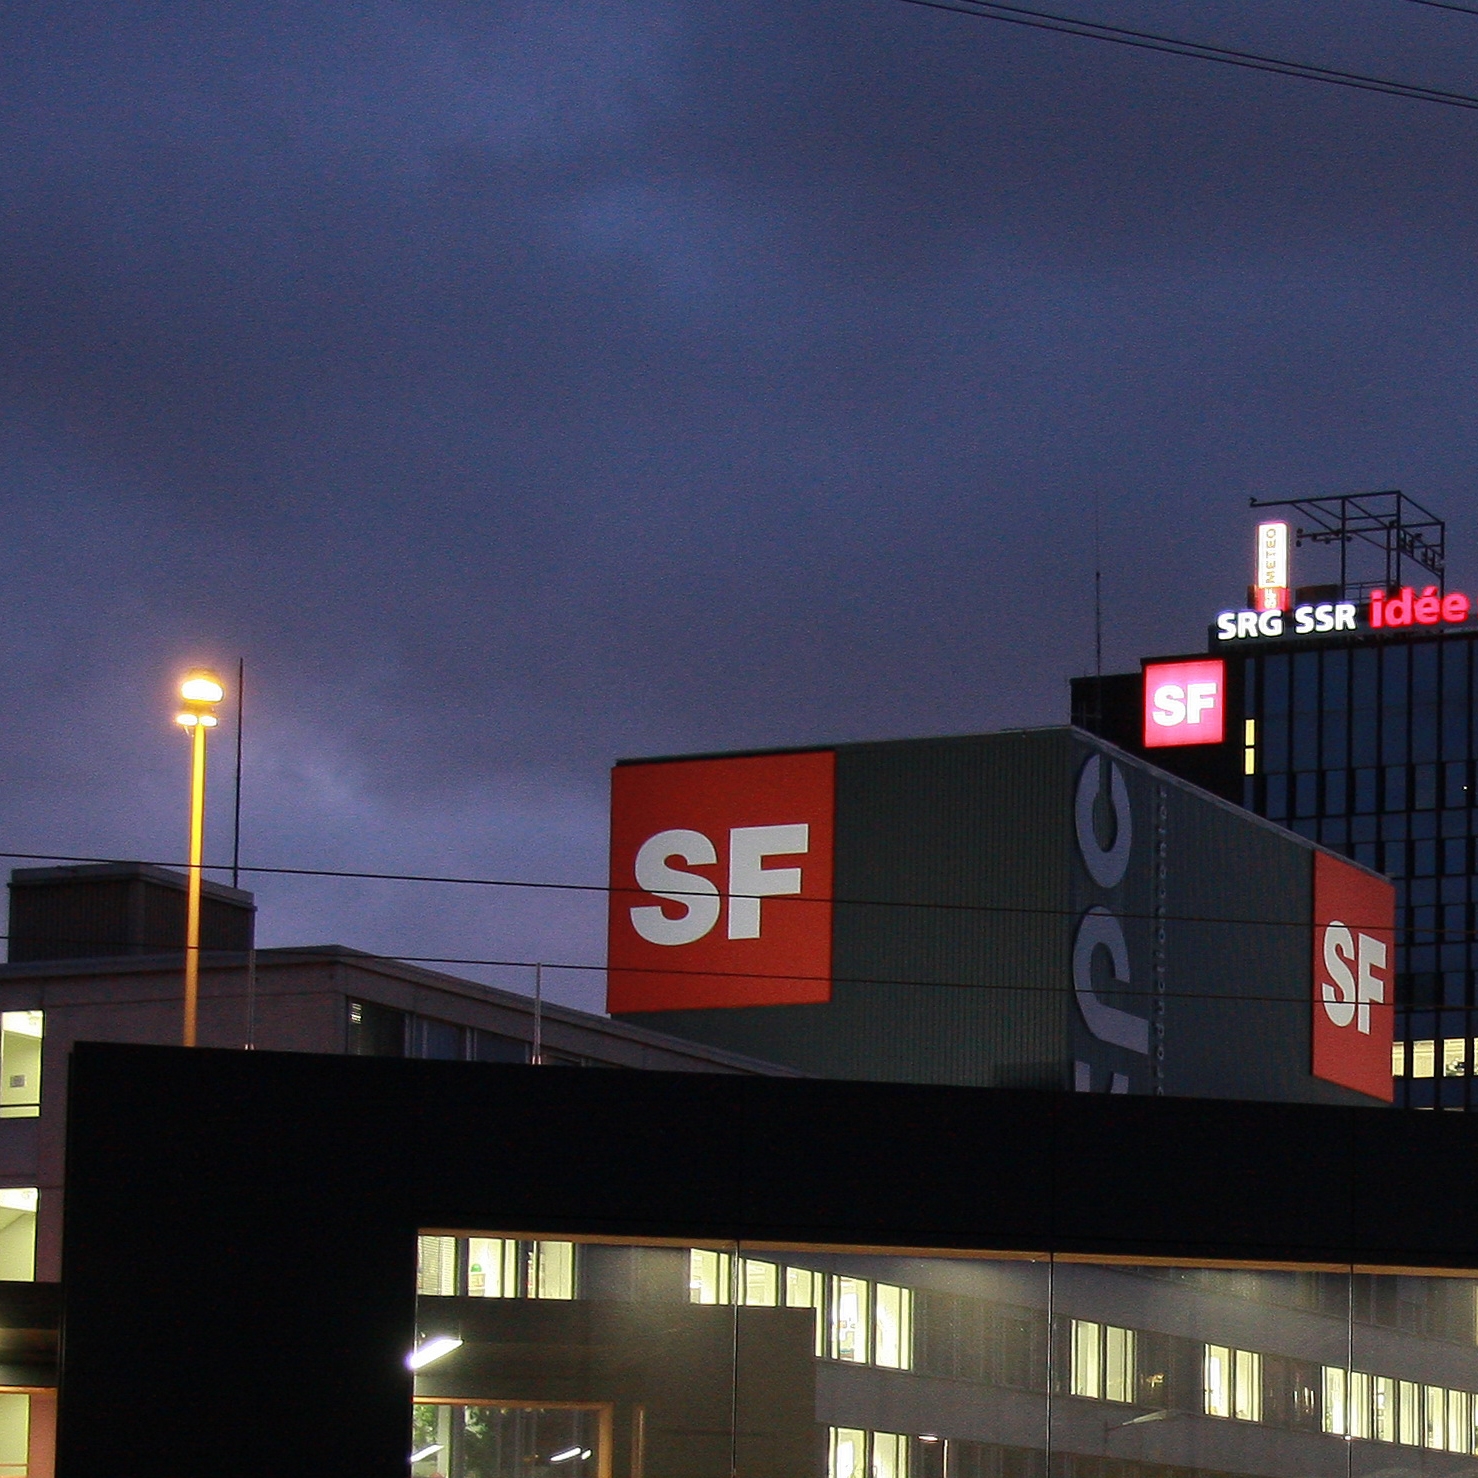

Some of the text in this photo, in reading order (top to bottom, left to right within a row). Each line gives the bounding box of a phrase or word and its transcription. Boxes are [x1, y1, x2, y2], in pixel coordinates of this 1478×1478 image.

[1264, 527, 1277, 584] METEO
[1217, 610, 1283, 641] SRG
[1294, 603, 1357, 635] SSR
[1369, 586, 1470, 628] idée
[1152, 682, 1217, 728] SF
[629, 823, 809, 947] SF
[1321, 920, 1388, 1035] SF
